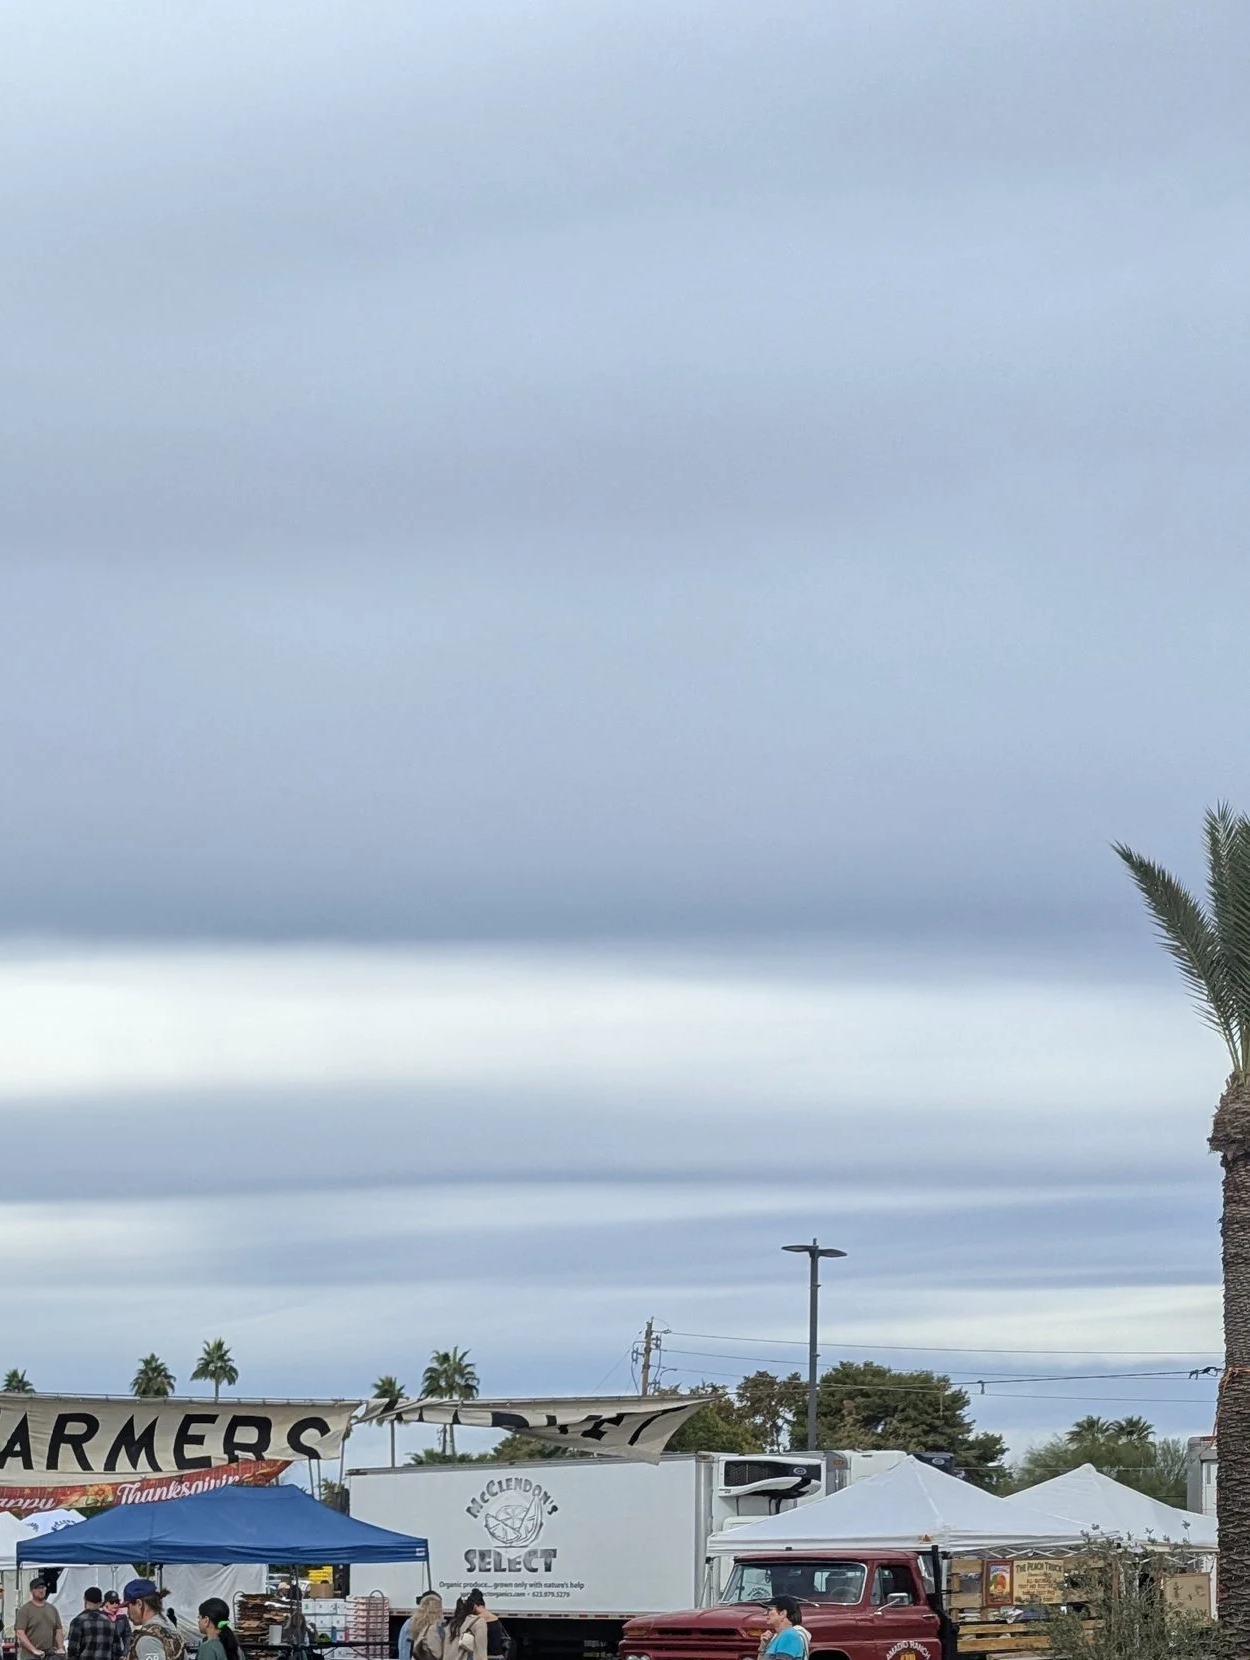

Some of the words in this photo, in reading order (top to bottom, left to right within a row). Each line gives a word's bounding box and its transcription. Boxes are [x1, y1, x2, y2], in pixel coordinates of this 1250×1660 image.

[464, 1548, 558, 1573] SELECT
[439, 1581, 462, 1590] Organic
[514, 1581, 528, 1590] only
[528, 1581, 543, 1589] with
[544, 1581, 569, 1590] nature's
[570, 1581, 585, 1591] help
